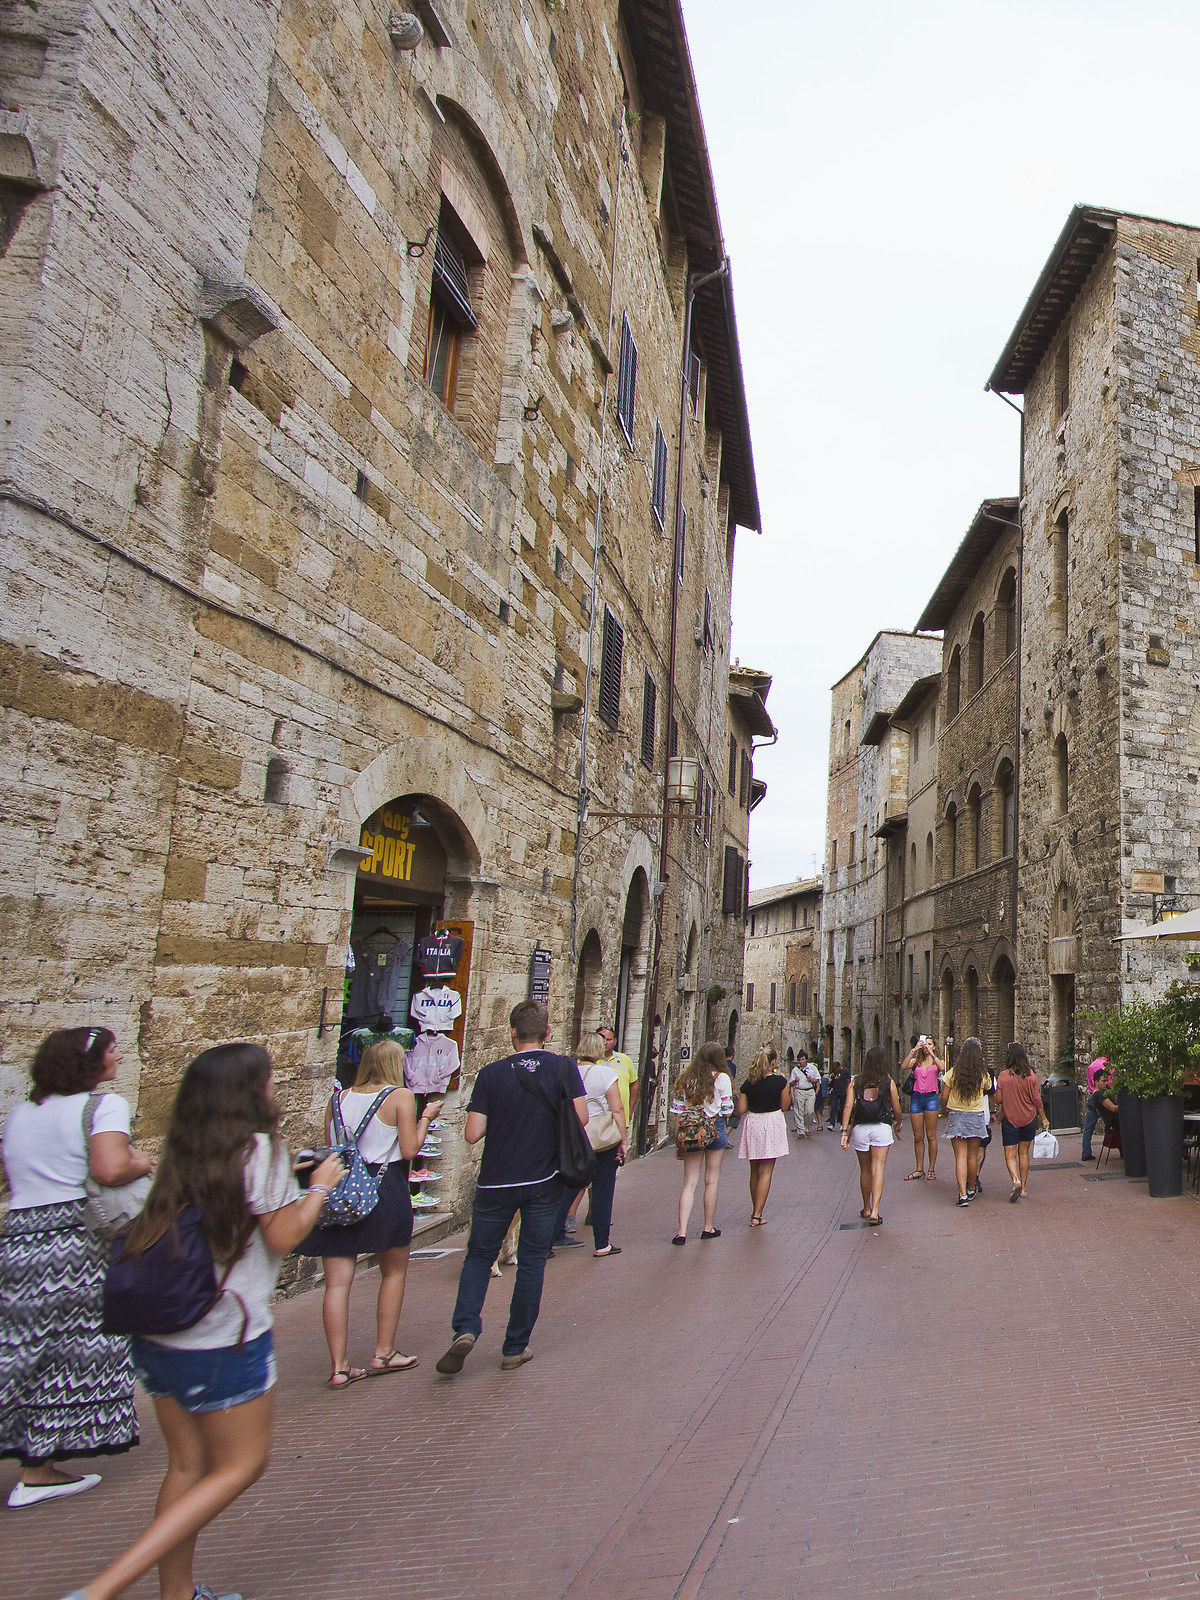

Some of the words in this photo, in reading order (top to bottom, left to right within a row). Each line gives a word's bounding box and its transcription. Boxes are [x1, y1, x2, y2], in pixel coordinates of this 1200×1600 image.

[360, 829, 416, 881] SPORT
[426, 947, 451, 956] ITALIA
[421, 999, 453, 1008] ITALIA
[659, 1049, 669, 1119] ORTURA
